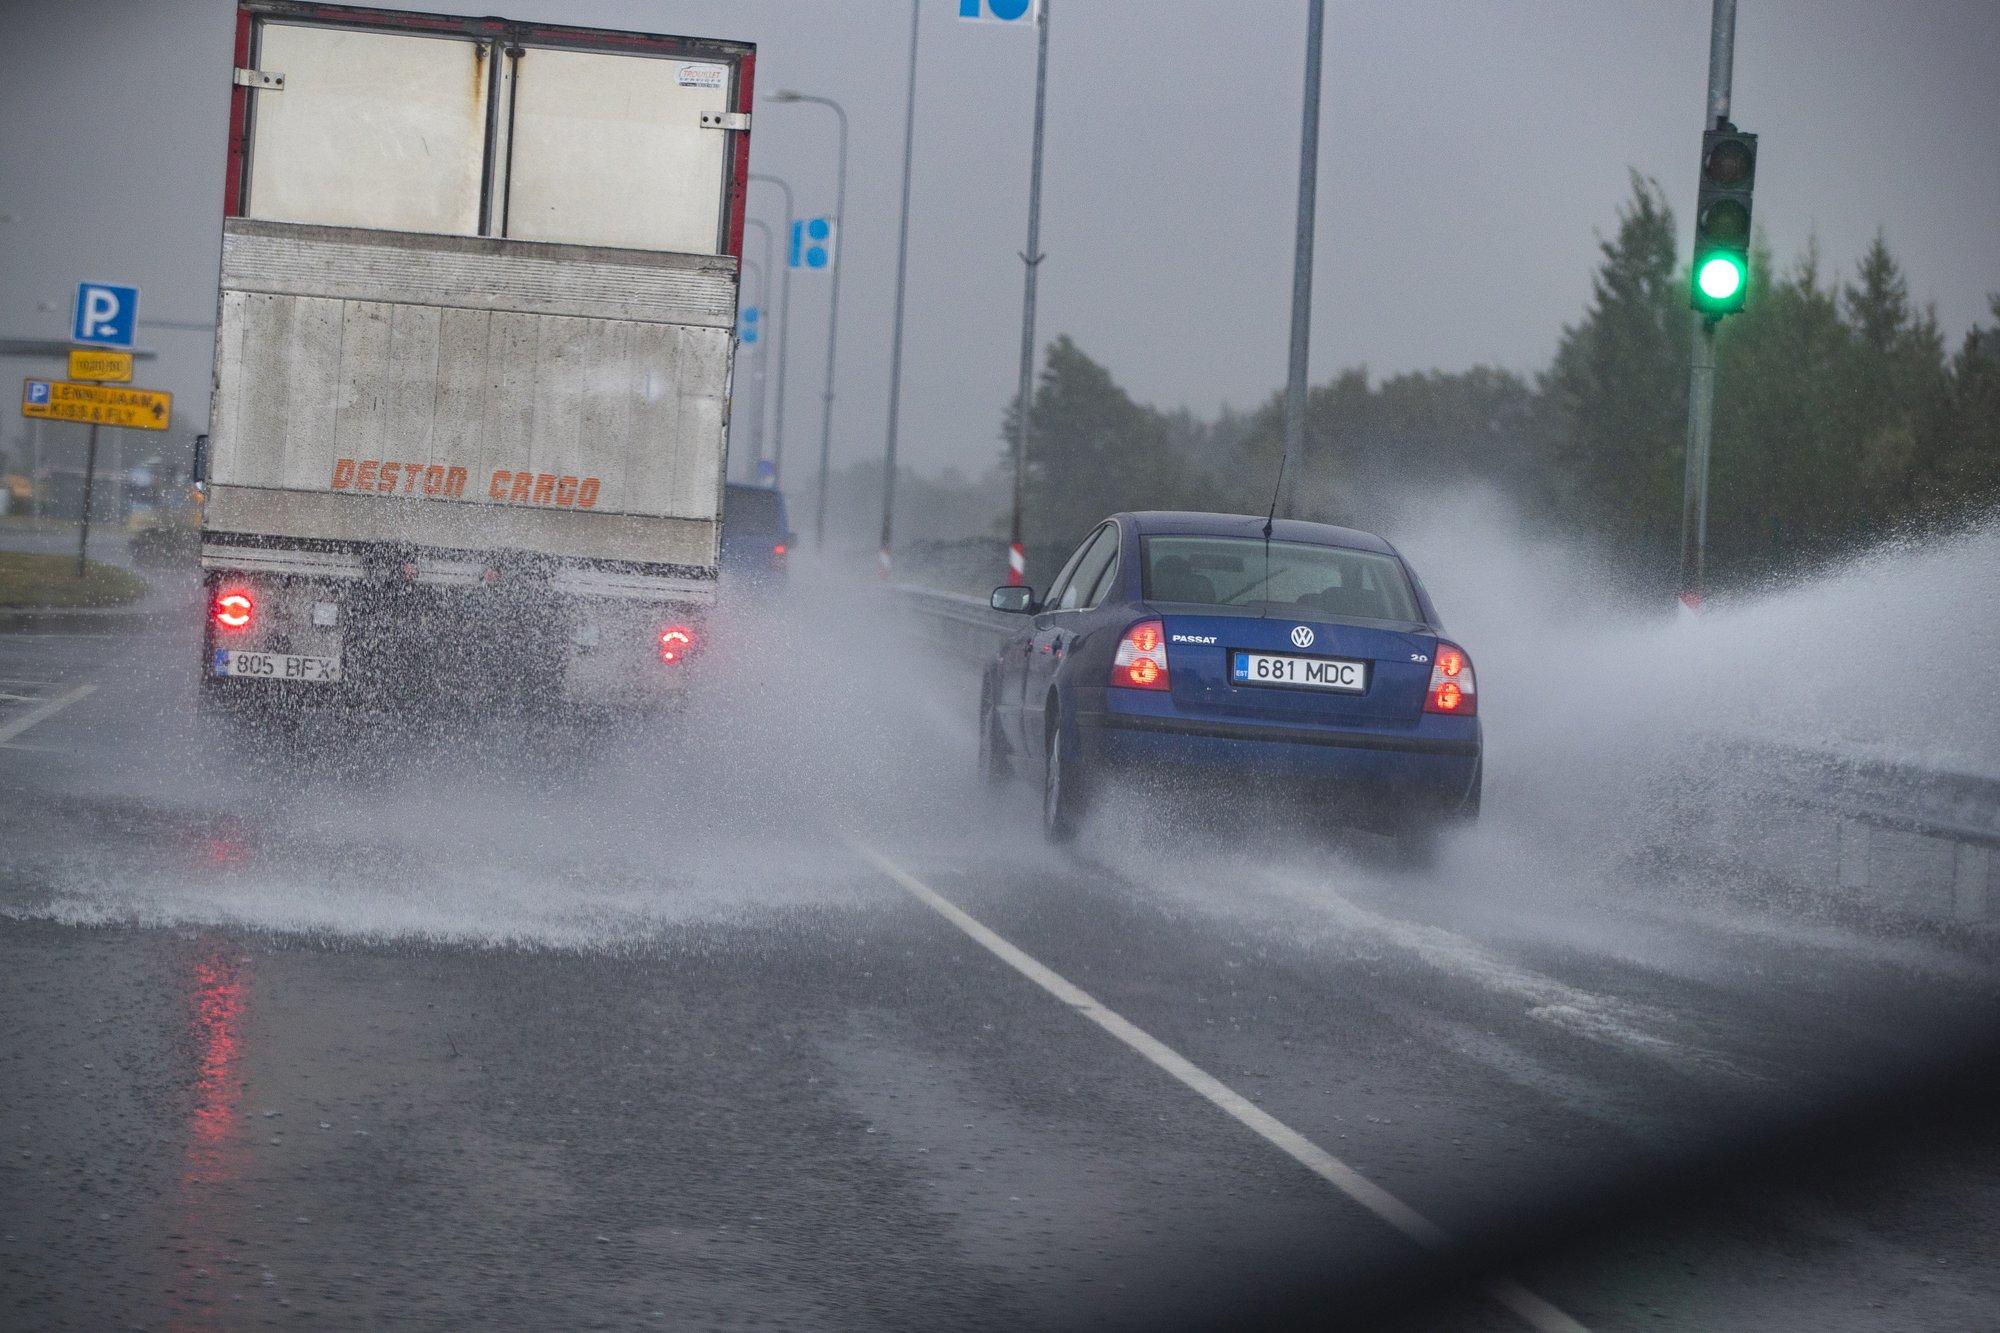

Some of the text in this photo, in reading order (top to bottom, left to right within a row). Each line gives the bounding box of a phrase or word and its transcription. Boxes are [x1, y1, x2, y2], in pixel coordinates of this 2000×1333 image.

[83, 289, 119, 337] P
[31, 383, 46, 402] P
[331, 458, 601, 509] DESTON CARGO
[1172, 634, 1217, 644] PASSAT
[237, 654, 274, 675] 805
[285, 656, 332, 680] BFX
[1235, 669, 1248, 678] EST
[1257, 658, 1355, 685] 681 MDC
